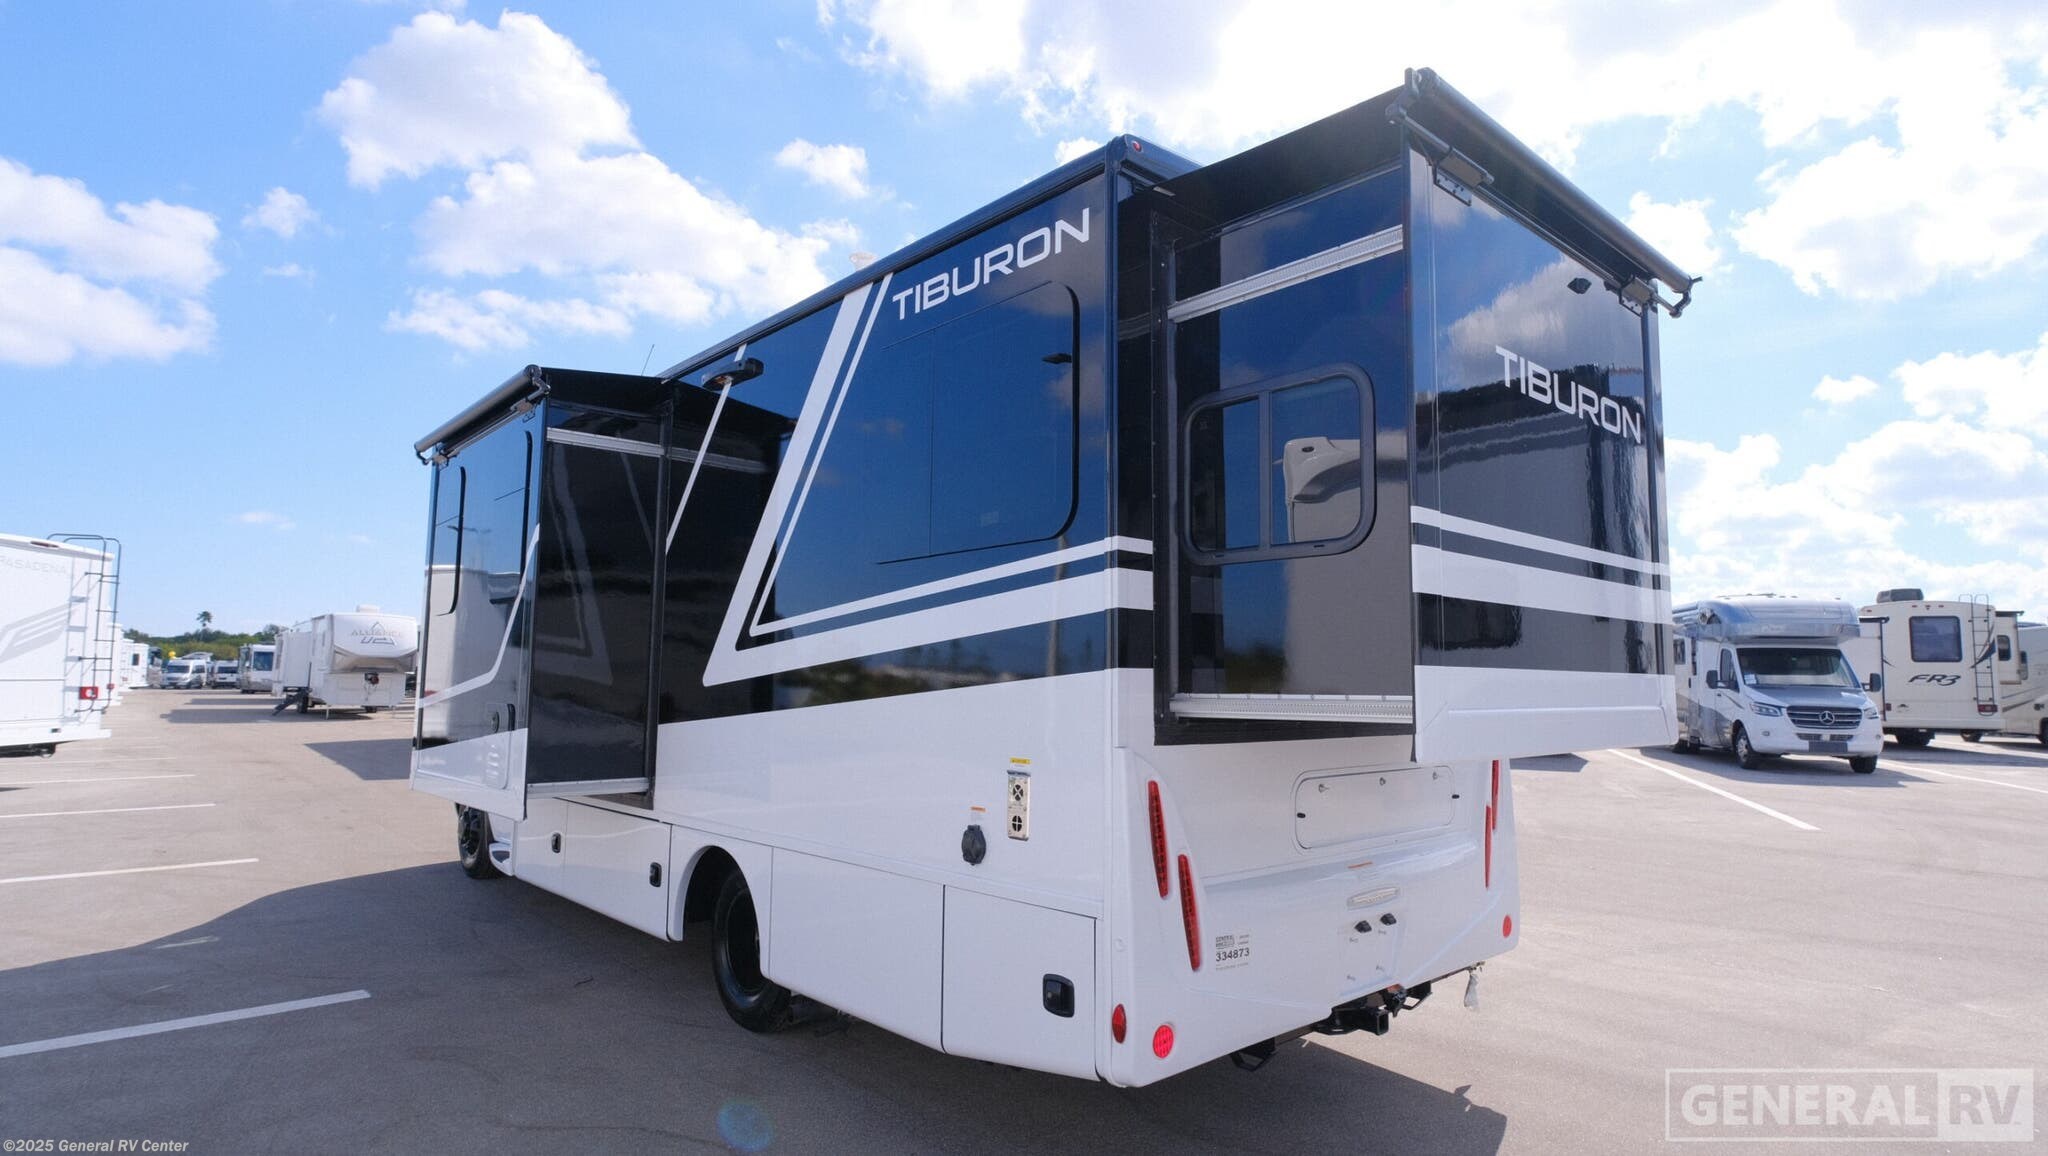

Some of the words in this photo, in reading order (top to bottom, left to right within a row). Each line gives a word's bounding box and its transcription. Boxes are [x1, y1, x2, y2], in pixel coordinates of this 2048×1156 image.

[892, 207, 1090, 321] TIBURON
[1495, 344, 1642, 444] TIBURON
[1908, 673, 1962, 687] FR3
[1215, 947, 1250, 962] 334873
